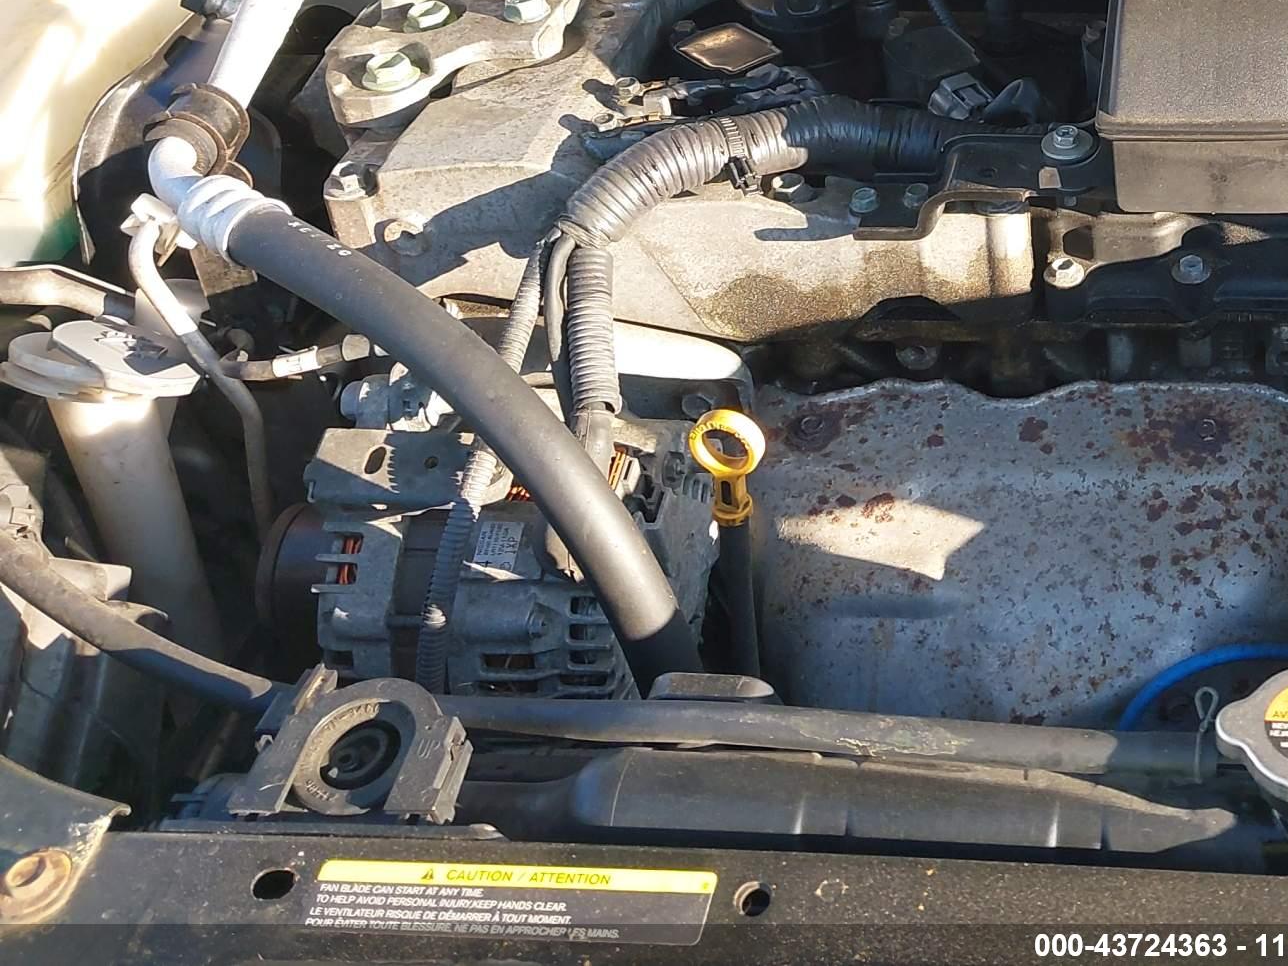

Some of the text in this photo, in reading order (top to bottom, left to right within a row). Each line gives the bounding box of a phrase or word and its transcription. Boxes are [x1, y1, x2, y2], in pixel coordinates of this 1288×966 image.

[446, 869, 514, 883] CAUTION
[529, 872, 612, 885] ATTENTION
[319, 883, 339, 893] FAN
[340, 884, 371, 894] BLADE
[371, 885, 394, 895] CAN
[394, 885, 425, 896] START
[425, 886, 438, 896] AT
[438, 887, 460, 897] ANY
[316, 894, 329, 903] TO
[330, 894, 356, 905] HELP
[355, 895, 386, 906] AVOID
[386, 897, 438, 908] PERSONAL
[497, 900, 534, 911] HANDS
[533, 902, 567, 912] CLEAR.
[309, 907, 572, 925] LE VENTILATEUR RISQUE DE DÉMARRER À TOUT MOMENT.
[304, 918, 334, 927] POUR
[334, 918, 368, 928] ÉVITER
[368, 920, 399, 930] TOUTE
[453, 923, 469, 933] NE
[468, 924, 491, 934] PAS
[490, 925, 505, 934] EN
[504, 925, 567, 937] APPROCHER
[586, 928, 620, 939] MAINS.
